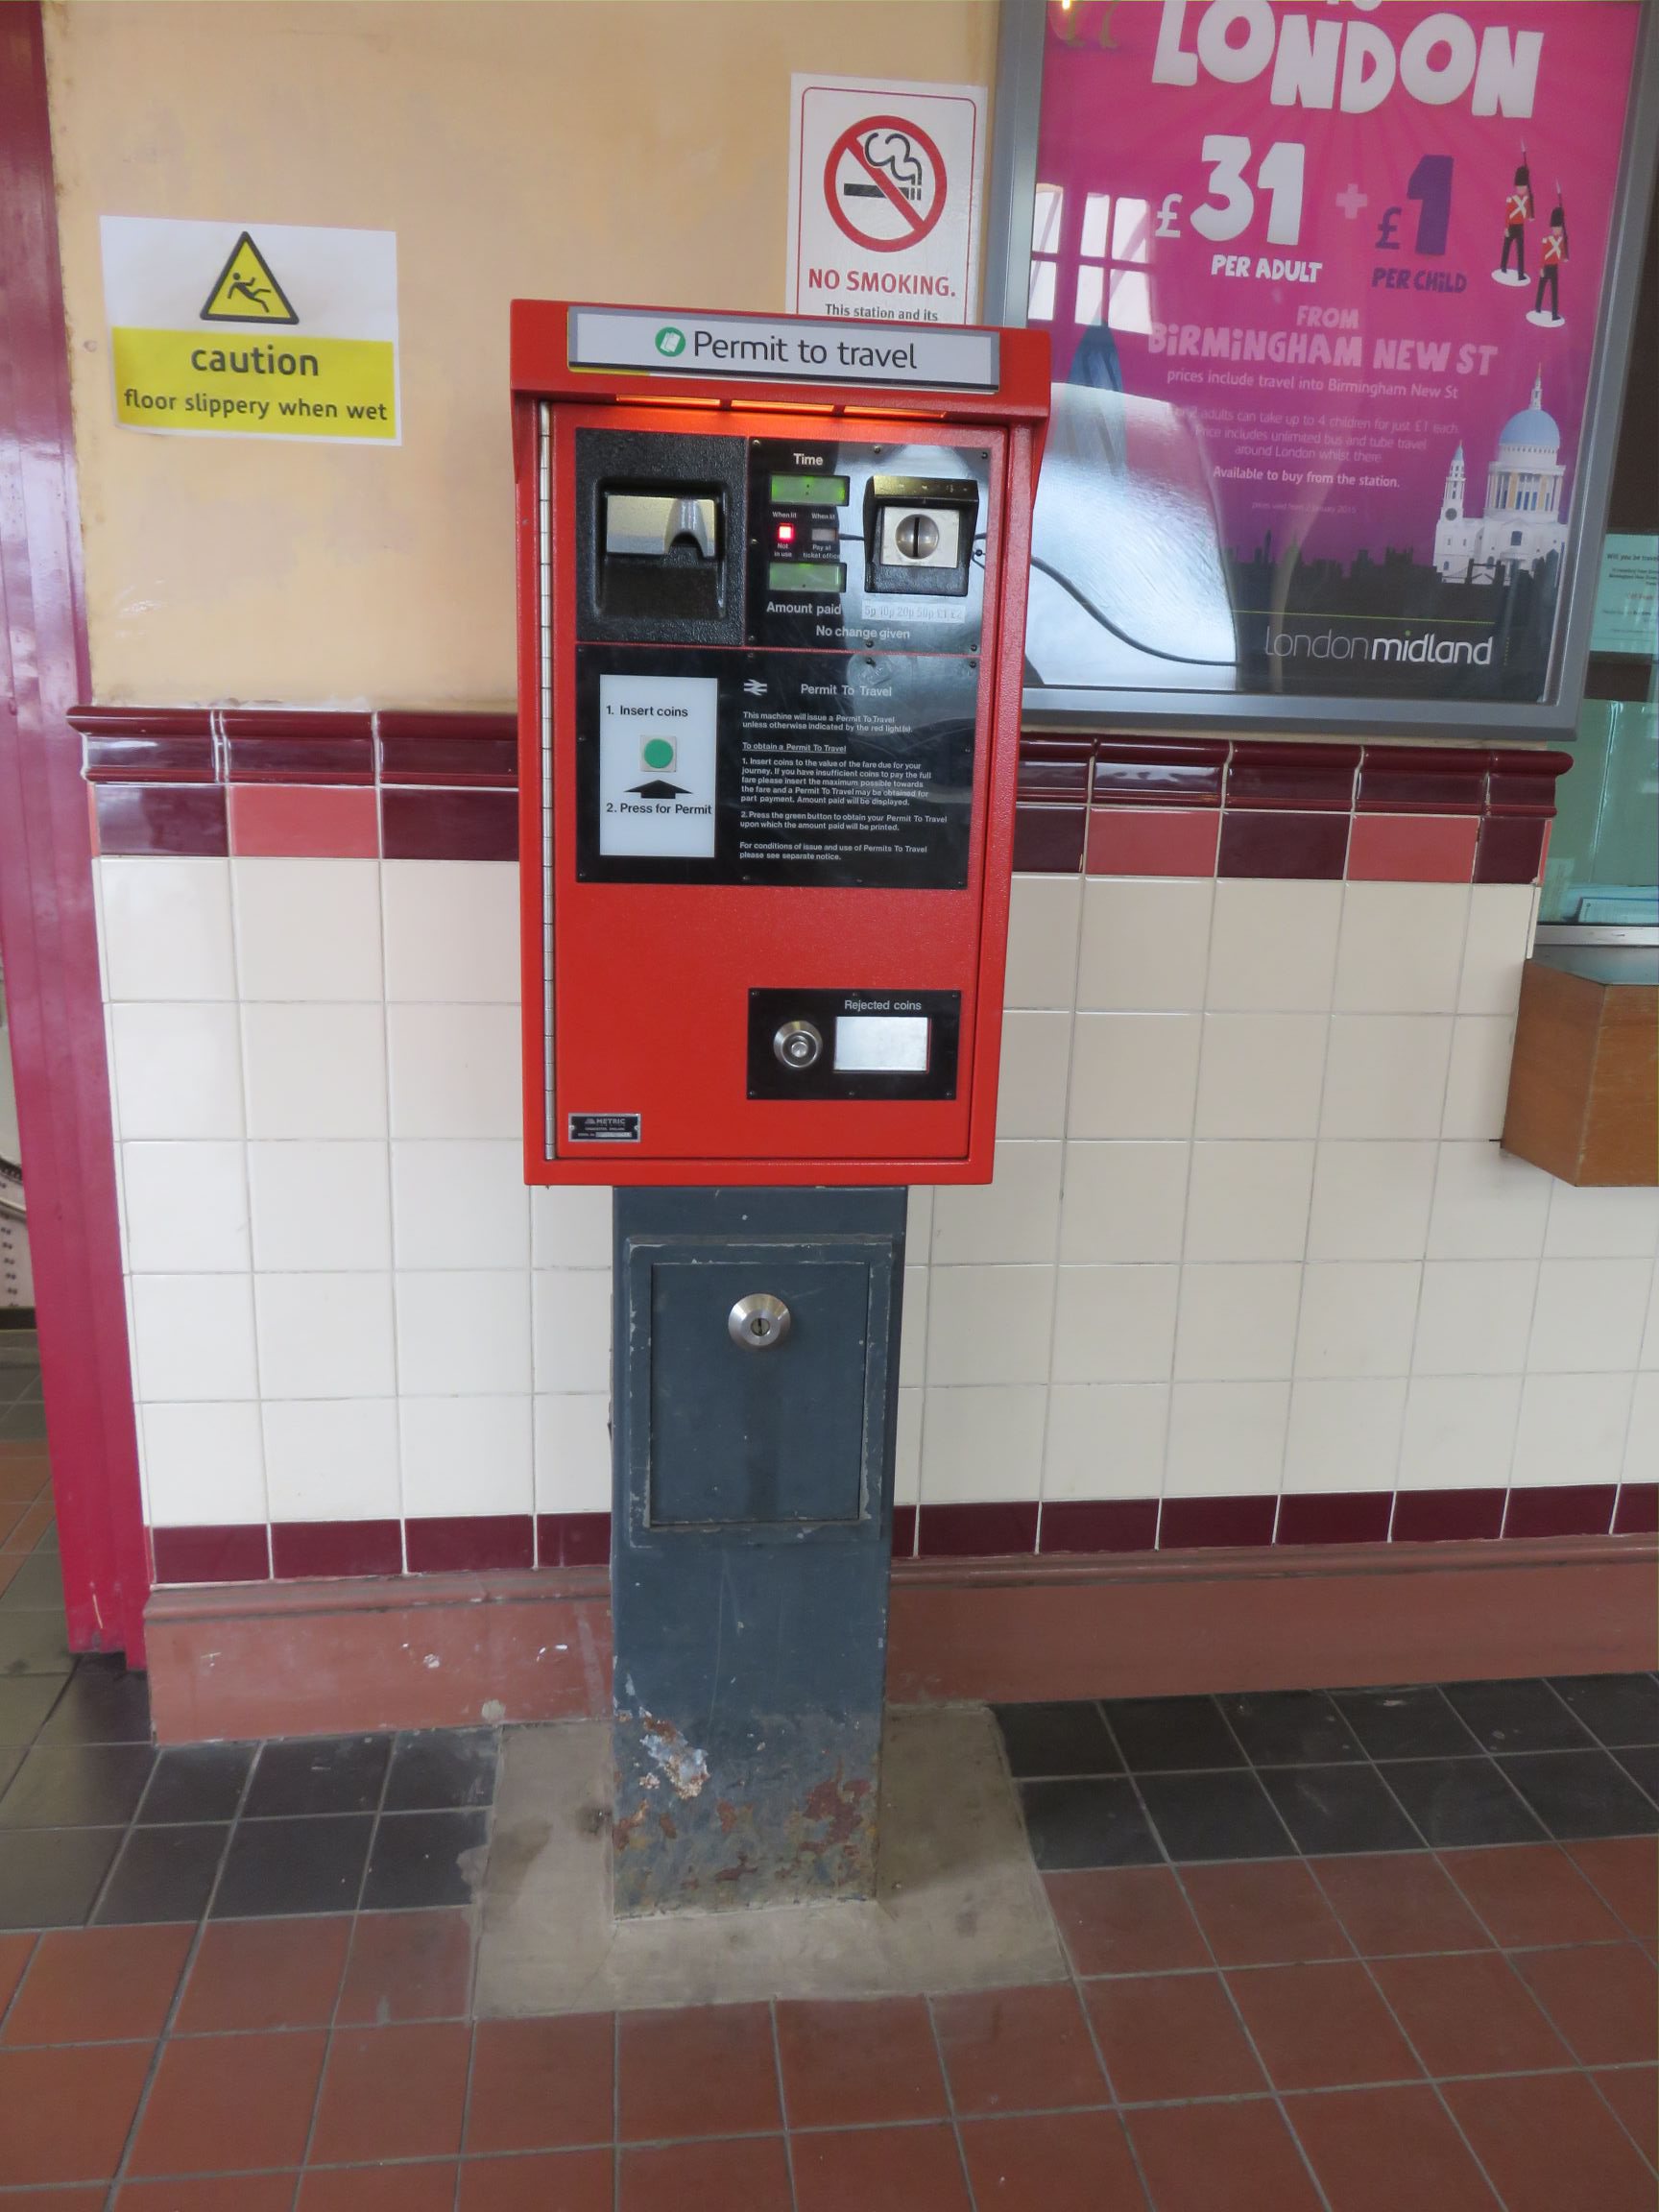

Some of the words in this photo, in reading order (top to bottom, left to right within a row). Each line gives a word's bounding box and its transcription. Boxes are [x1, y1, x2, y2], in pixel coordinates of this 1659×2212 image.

[1151, 0, 1544, 118] LONDON
[1211, 254, 1249, 277] PER
[1256, 257, 1323, 283] ADULT
[808, 268, 840, 289] NO
[846, 270, 956, 297] SMOKING.
[1371, 267, 1408, 290] PER
[826, 303, 850, 317] This
[854, 306, 895, 320] station
[899, 308, 920, 321] and
[924, 309, 938, 322] its
[1296, 305, 1359, 329] FROM
[693, 330, 788, 363] Permit
[797, 339, 828, 365] to
[837, 341, 918, 370] travel
[1373, 338, 1452, 373] NEW
[1455, 343, 1499, 375] ST
[191, 344, 319, 376] caution
[1166, 368, 1204, 384] prices
[1208, 369, 1254, 386] include
[1259, 374, 1294, 389] travel
[1299, 375, 1324, 391] into
[1328, 378, 1407, 398] Birmingham
[1410, 384, 1441, 397] New
[1445, 385, 1458, 398] St
[124, 389, 177, 411] floor
[184, 393, 270, 420] slippery
[278, 398, 338, 419] when
[347, 403, 388, 421] wet
[1237, 413, 1256, 422] can
[1260, 412, 1283, 424] take
[1286, 416, 1299, 425] up
[1303, 415, 1314, 425] to
[1329, 416, 1371, 429] children
[1224, 427, 1268, 442] includes
[1270, 431, 1321, 445] unlimited
[1324, 434, 1343, 445] bus
[1346, 435, 1367, 446] and
[1370, 437, 1394, 449] tube
[1398, 438, 1427, 450] travel
[1235, 445, 1272, 456] around
[1276, 445, 1315, 458] London
[793, 452, 824, 466] Time
[1213, 466, 1263, 480] Available
[1266, 469, 1279, 481] to
[1282, 469, 1304, 485] buy
[1307, 471, 1334, 483] from
[1337, 473, 1357, 486] the
[1358, 475, 1401, 489] station.
[766, 601, 813, 614] Amount
[817, 602, 841, 615] paid
[816, 625, 832, 637] No
[834, 625, 878, 640] change
[878, 627, 910, 641] given
[801, 683, 839, 697] Permit
[842, 684, 854, 697] To
[859, 685, 892, 698] Travel
[606, 706, 614, 715] 1.
[620, 705, 654, 716] Insert
[657, 706, 688, 717] coins
[743, 710, 759, 719] This
[760, 711, 792, 720] machine
[794, 712, 806, 721] will
[807, 713, 827, 722] issue
[835, 714, 861, 723] Permit
[874, 714, 895, 723] Travel
[742, 720, 767, 729] unless
[769, 721, 807, 730] otherwise
[808, 722, 844, 731] indicated
[753, 742, 778, 751] obtain
[786, 743, 811, 752] Permit
[824, 744, 847, 753] Travel
[750, 757, 772, 766] Insert
[818, 759, 838, 768] value
[862, 760, 878, 769] fare
[796, 768, 814, 777] have
[815, 768, 858, 778] insufficient
[905, 771, 918, 780] the
[919, 771, 931, 780] full
[741, 776, 757, 784] fare
[757, 777, 783, 785] please
[822, 778, 858, 786] maximum
[860, 779, 892, 788] possible
[893, 780, 924, 788] towards
[756, 785, 771, 794] fare
[795, 786, 820, 795] Permit
[831, 787, 854, 796] Travel
[854, 789, 871, 798] may
[882, 789, 916, 798] obtained
[740, 795, 757, 804] part
[759, 796, 795, 805] payment.
[797, 795, 827, 805] Amount
[828, 796, 845, 805] paid
[871, 797, 910, 806] displayed.
[606, 803, 617, 813] 2.
[620, 803, 653, 814] Press
[655, 803, 673, 814] for
[675, 804, 712, 815] Permit
[749, 810, 770, 819] Press
[785, 812, 806, 821] green
[807, 812, 832, 821] button
[842, 813, 866, 822] obtain
[867, 814, 883, 823] your
[886, 814, 912, 823] Permit
[925, 815, 948, 824] Travel
[760, 821, 782, 830] which
[783, 821, 797, 830] the
[828, 822, 845, 830] paid
[845, 822, 858, 830] will
[870, 823, 900, 832] printed.
[739, 841, 752, 850] For
[754, 841, 793, 850] conditions
[904, 845, 927, 854] Travel
[739, 851, 764, 859] please
[781, 852, 815, 861] separate
[844, 999, 890, 1013] Rejected
[893, 1000, 922, 1012] coins
